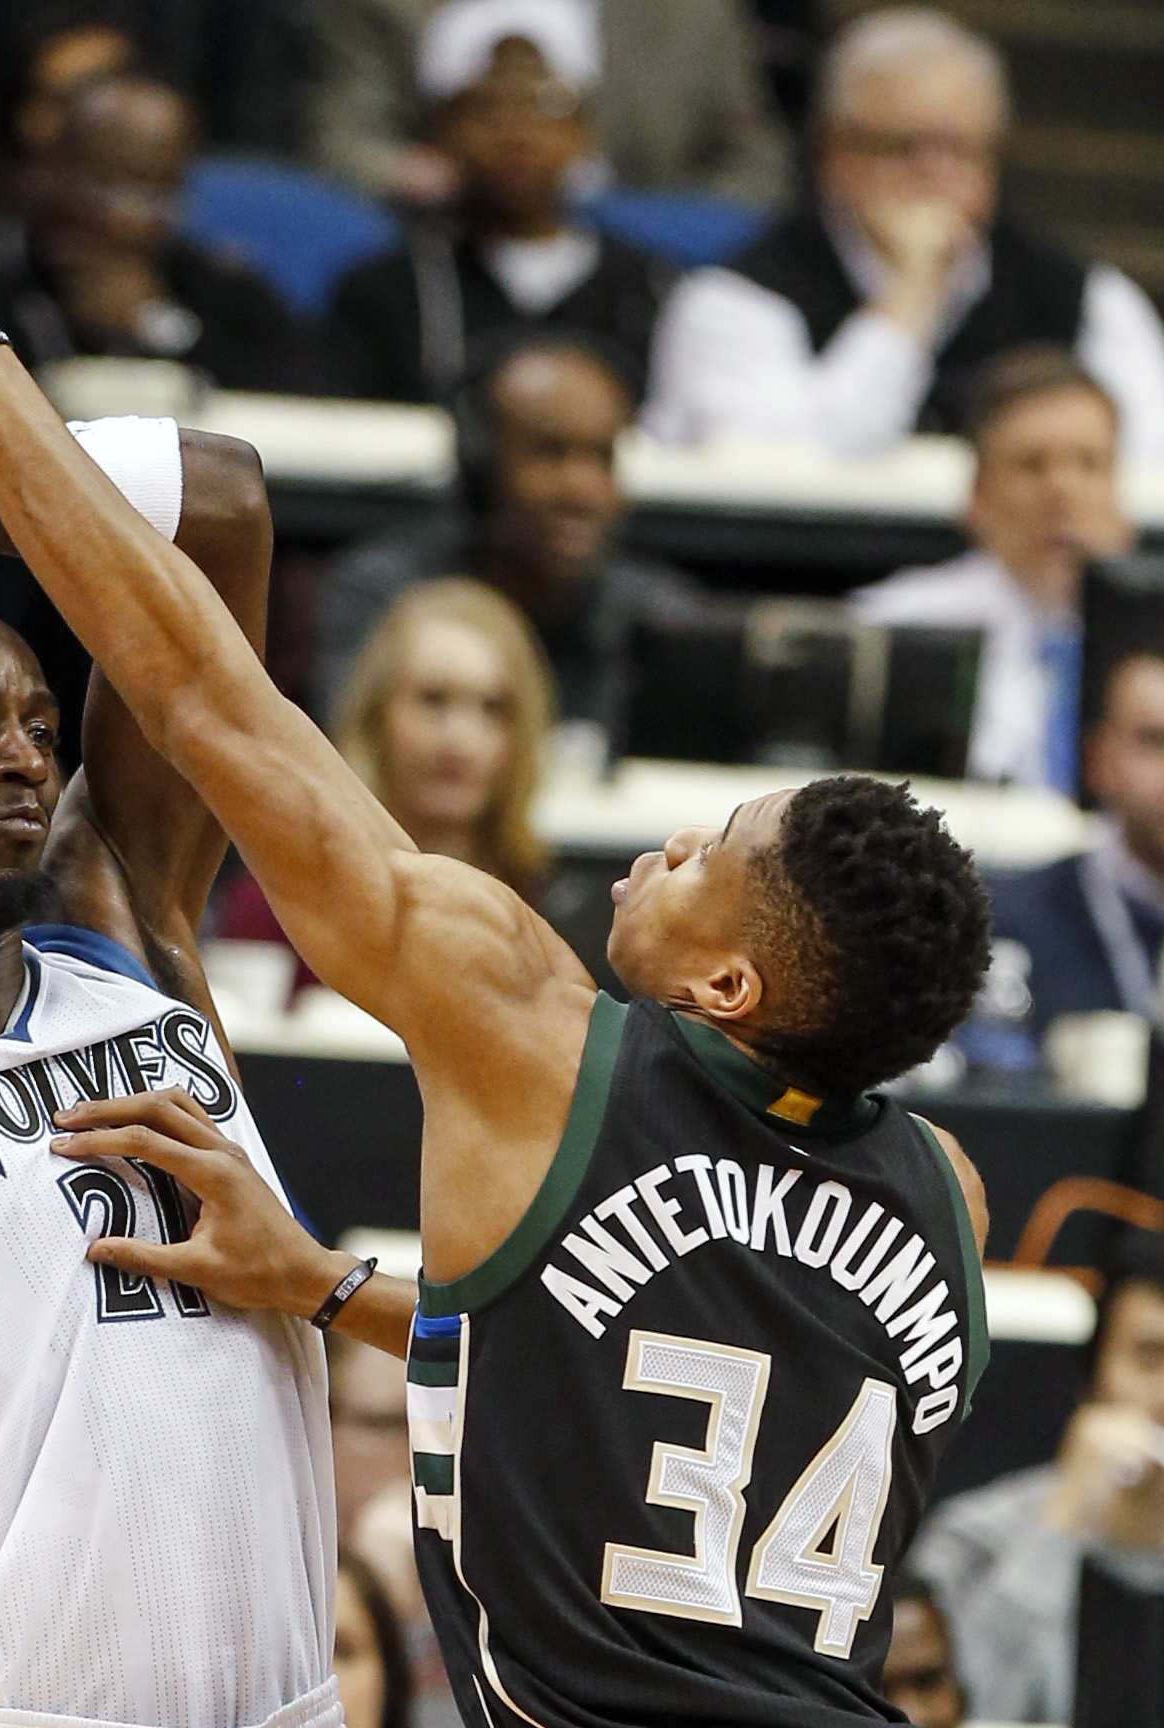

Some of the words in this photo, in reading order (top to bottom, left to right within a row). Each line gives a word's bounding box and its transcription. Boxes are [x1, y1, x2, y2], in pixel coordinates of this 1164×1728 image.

[57, 1157, 211, 1324] 21
[540, 1154, 963, 1435] ANTETOKOUNMPO
[600, 1329, 897, 1660] 34
